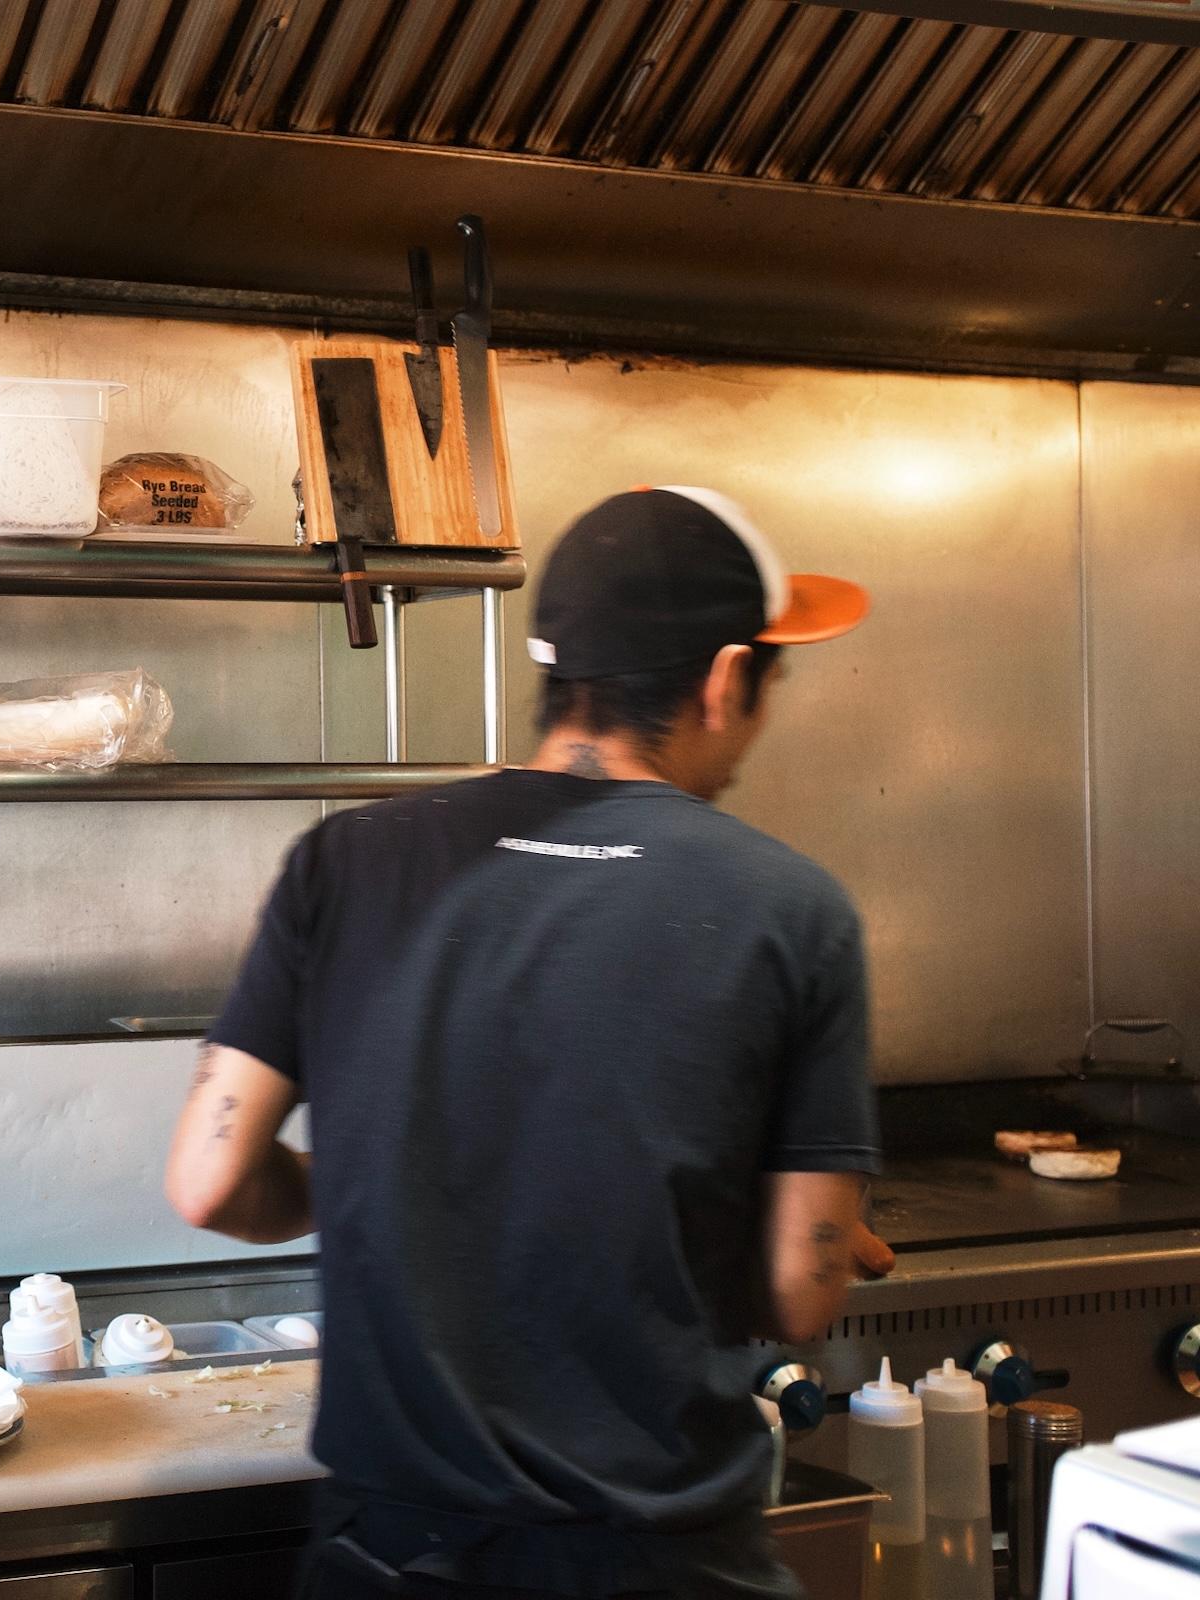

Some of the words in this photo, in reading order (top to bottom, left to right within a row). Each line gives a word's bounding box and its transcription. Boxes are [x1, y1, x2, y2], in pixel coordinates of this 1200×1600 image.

[142, 479, 166, 493] Rye
[152, 494, 199, 508] Seeded
[156, 511, 166, 523] 3
[168, 511, 192, 524] LBS
